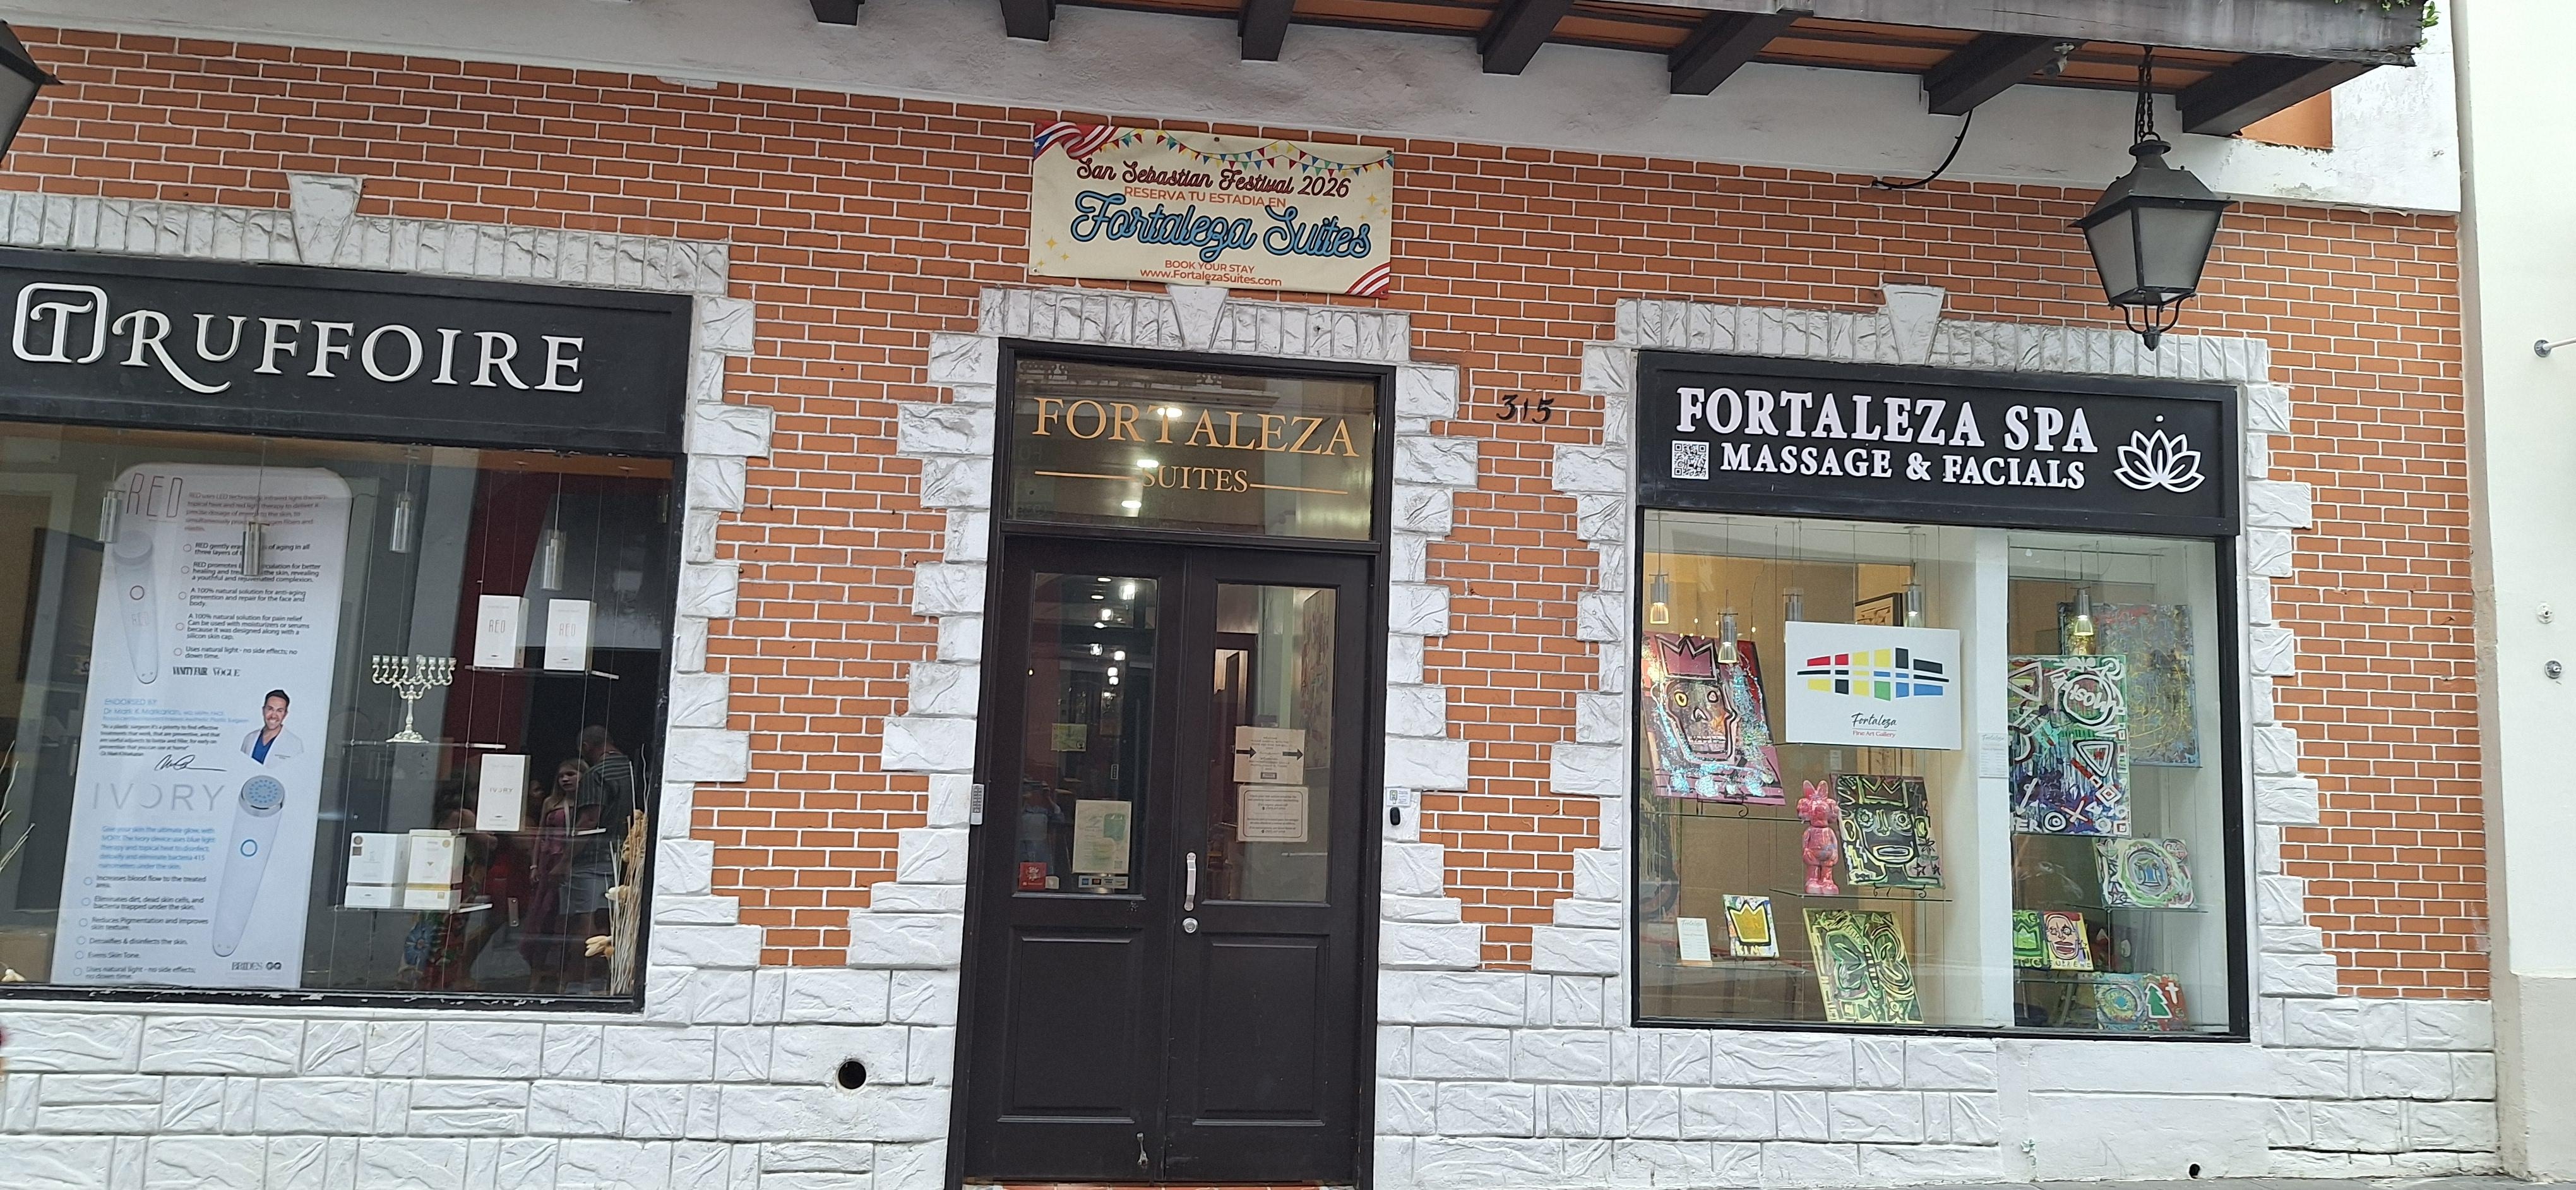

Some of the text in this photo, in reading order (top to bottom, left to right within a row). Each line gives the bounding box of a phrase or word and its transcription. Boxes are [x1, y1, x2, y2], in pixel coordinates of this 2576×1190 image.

[1076, 157, 1351, 198] San Sebastian Festival 2026
[1124, 186, 1286, 208] RESERVA TU ESTADIA EN
[1070, 190, 1371, 263] Fortaleza Suites
[1140, 269, 1282, 287] www.FortalezaSuites.com
[1165, 260, 1255, 273] BOOK YOUR STAY
[1496, 394, 1554, 424] 315
[1676, 387, 2098, 453] FORTALEZA SPA
[1032, 397, 1359, 457] FORTALEZA
[1142, 464, 1248, 493] SUITES
[1720, 442, 2085, 490] MASSAGE & FACIALS
[126, 473, 183, 518] RED
[489, 619, 506, 632] RED
[559, 623, 576, 637] RED
[1851, 712, 1897, 728] Fortaleza
[92, 783, 225, 812] IVORY
[266, 961, 282, 970] GQ
